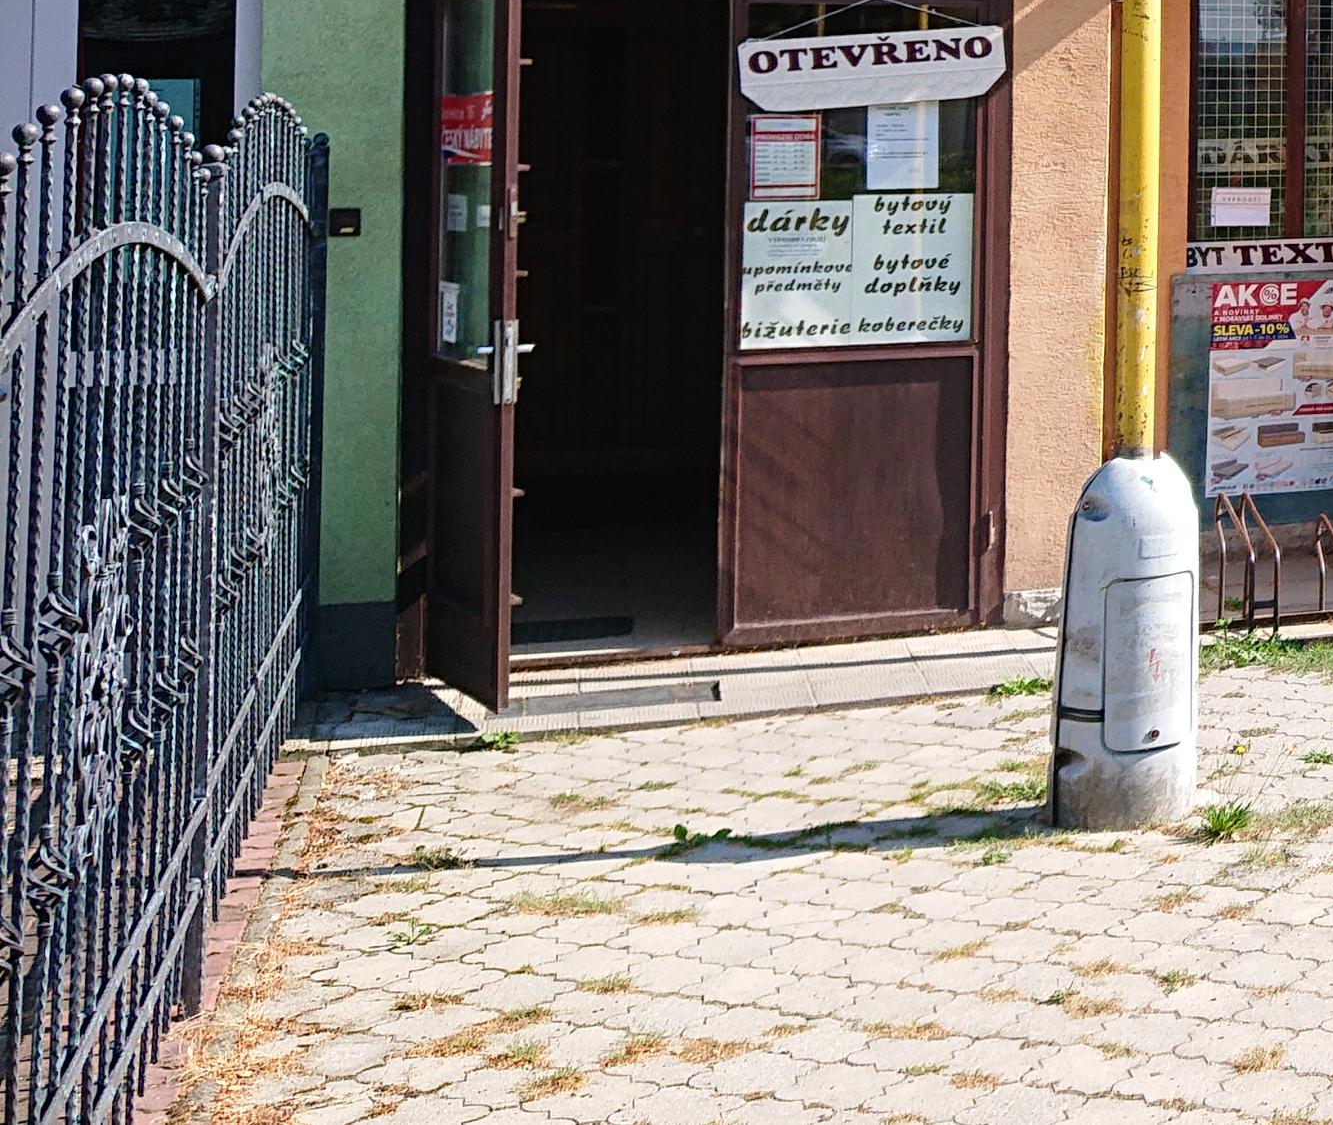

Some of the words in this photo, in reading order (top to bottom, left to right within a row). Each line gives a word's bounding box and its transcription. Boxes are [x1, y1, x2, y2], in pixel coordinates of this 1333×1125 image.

[749, 35, 993, 74] OTEVŘENO
[874, 196, 952, 215] bytový
[747, 208, 850, 236] dárky
[882, 218, 947, 235] textil
[873, 254, 952, 273] bytové
[1187, 247, 1225, 267] BYT
[754, 278, 841, 295] předměty
[864, 277, 961, 297] doplňky
[741, 319, 851, 340] bižuterie
[858, 316, 964, 333] koberečky
[1213, 324, 1254, 336] SLEVA
